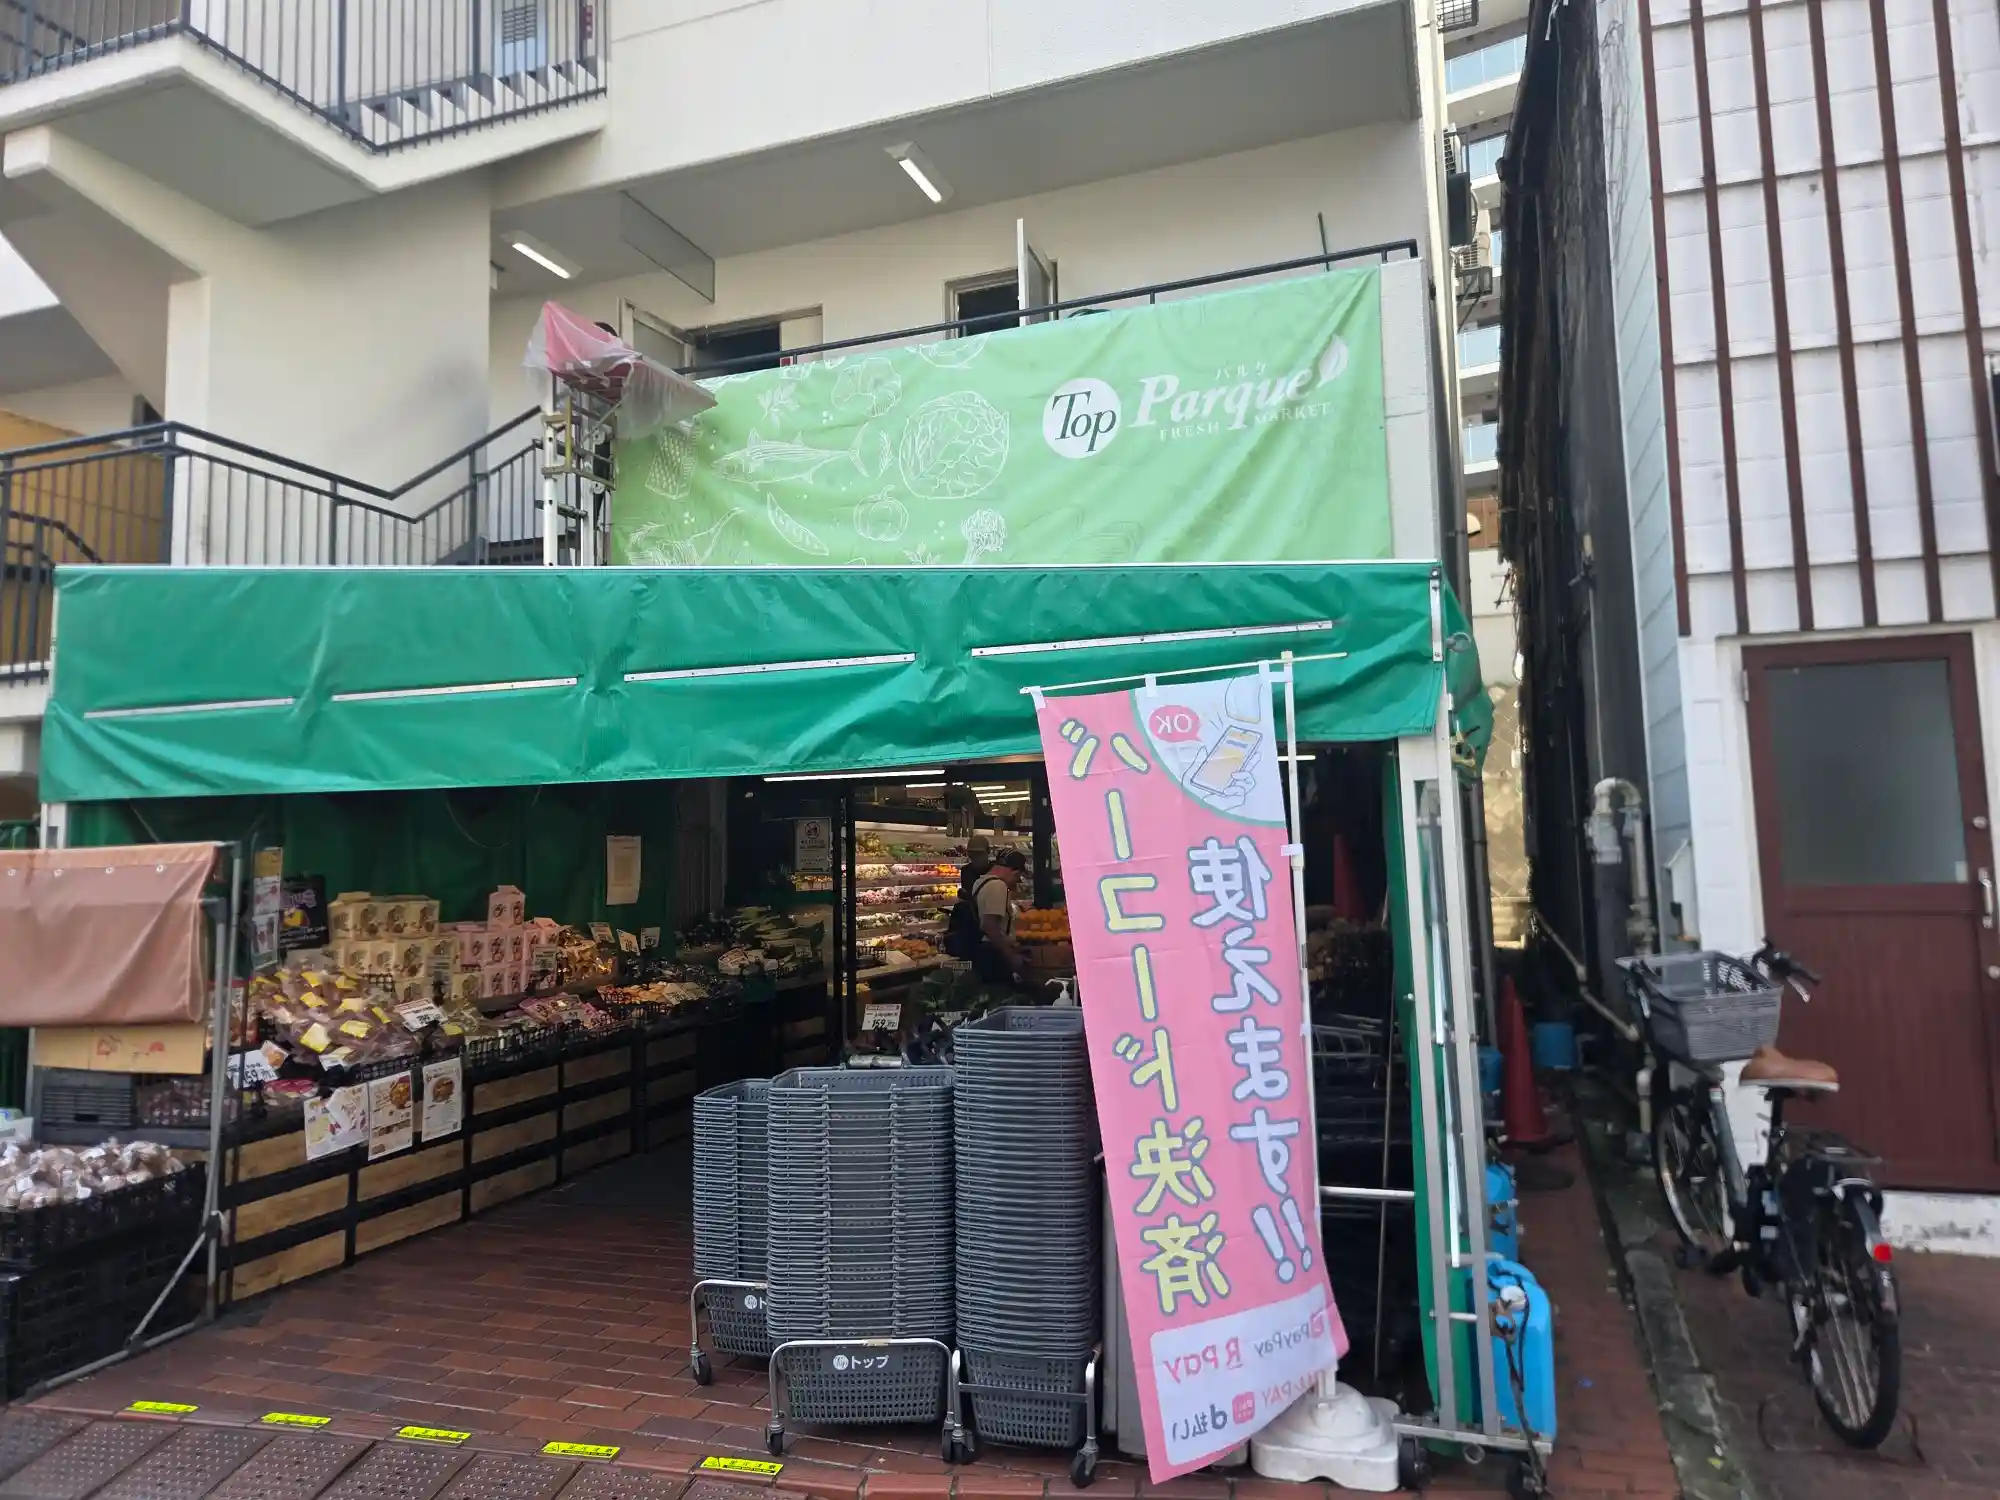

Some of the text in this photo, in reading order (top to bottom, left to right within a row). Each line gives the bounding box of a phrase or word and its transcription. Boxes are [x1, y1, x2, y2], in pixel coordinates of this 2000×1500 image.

[1051, 368, 1314, 453] Top Parque
[1159, 401, 1332, 442] FRESH MARKET
[851, 1354, 890, 1370] トップ
